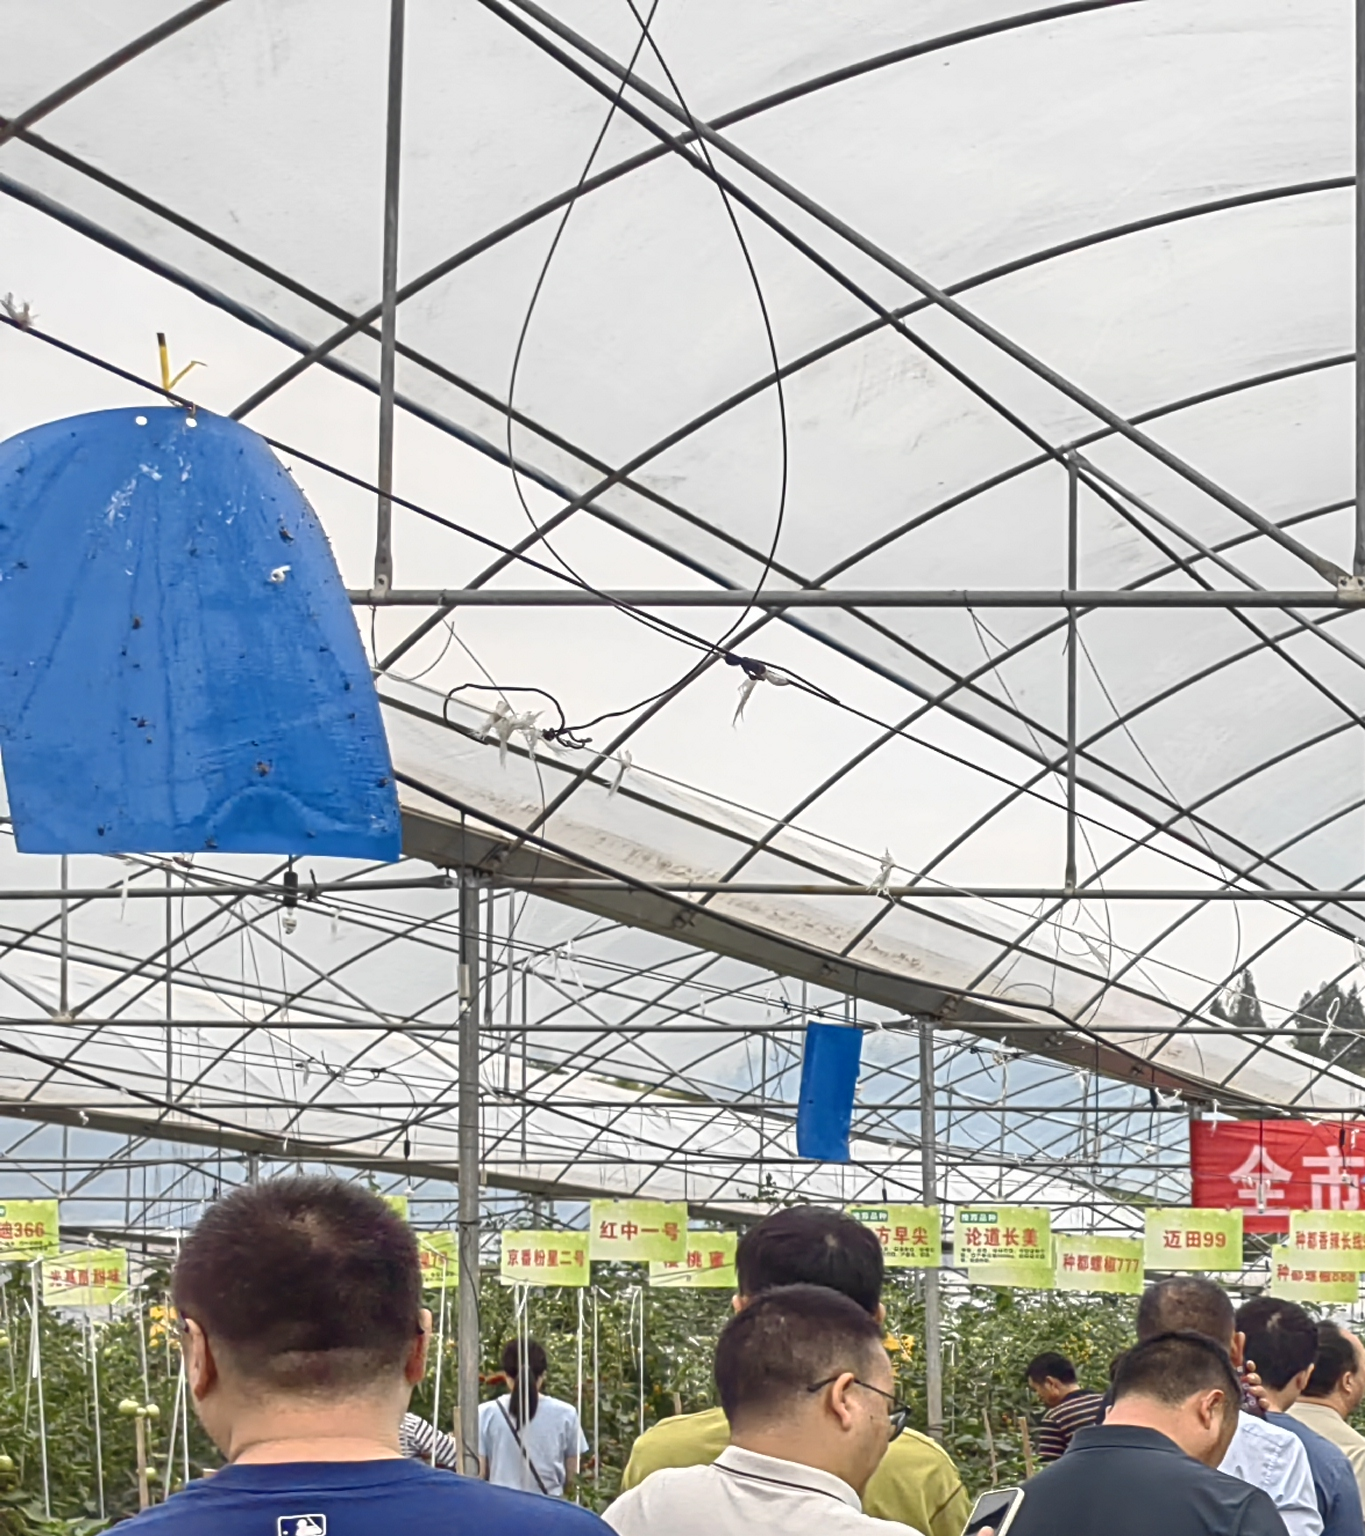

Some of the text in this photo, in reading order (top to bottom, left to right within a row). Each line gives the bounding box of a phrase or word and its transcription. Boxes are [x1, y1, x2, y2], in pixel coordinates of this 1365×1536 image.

[600, 1221, 680, 1242] 红中一号
[874, 1226, 929, 1246] 方早尖
[1163, 1230, 1227, 1249] 迈田99
